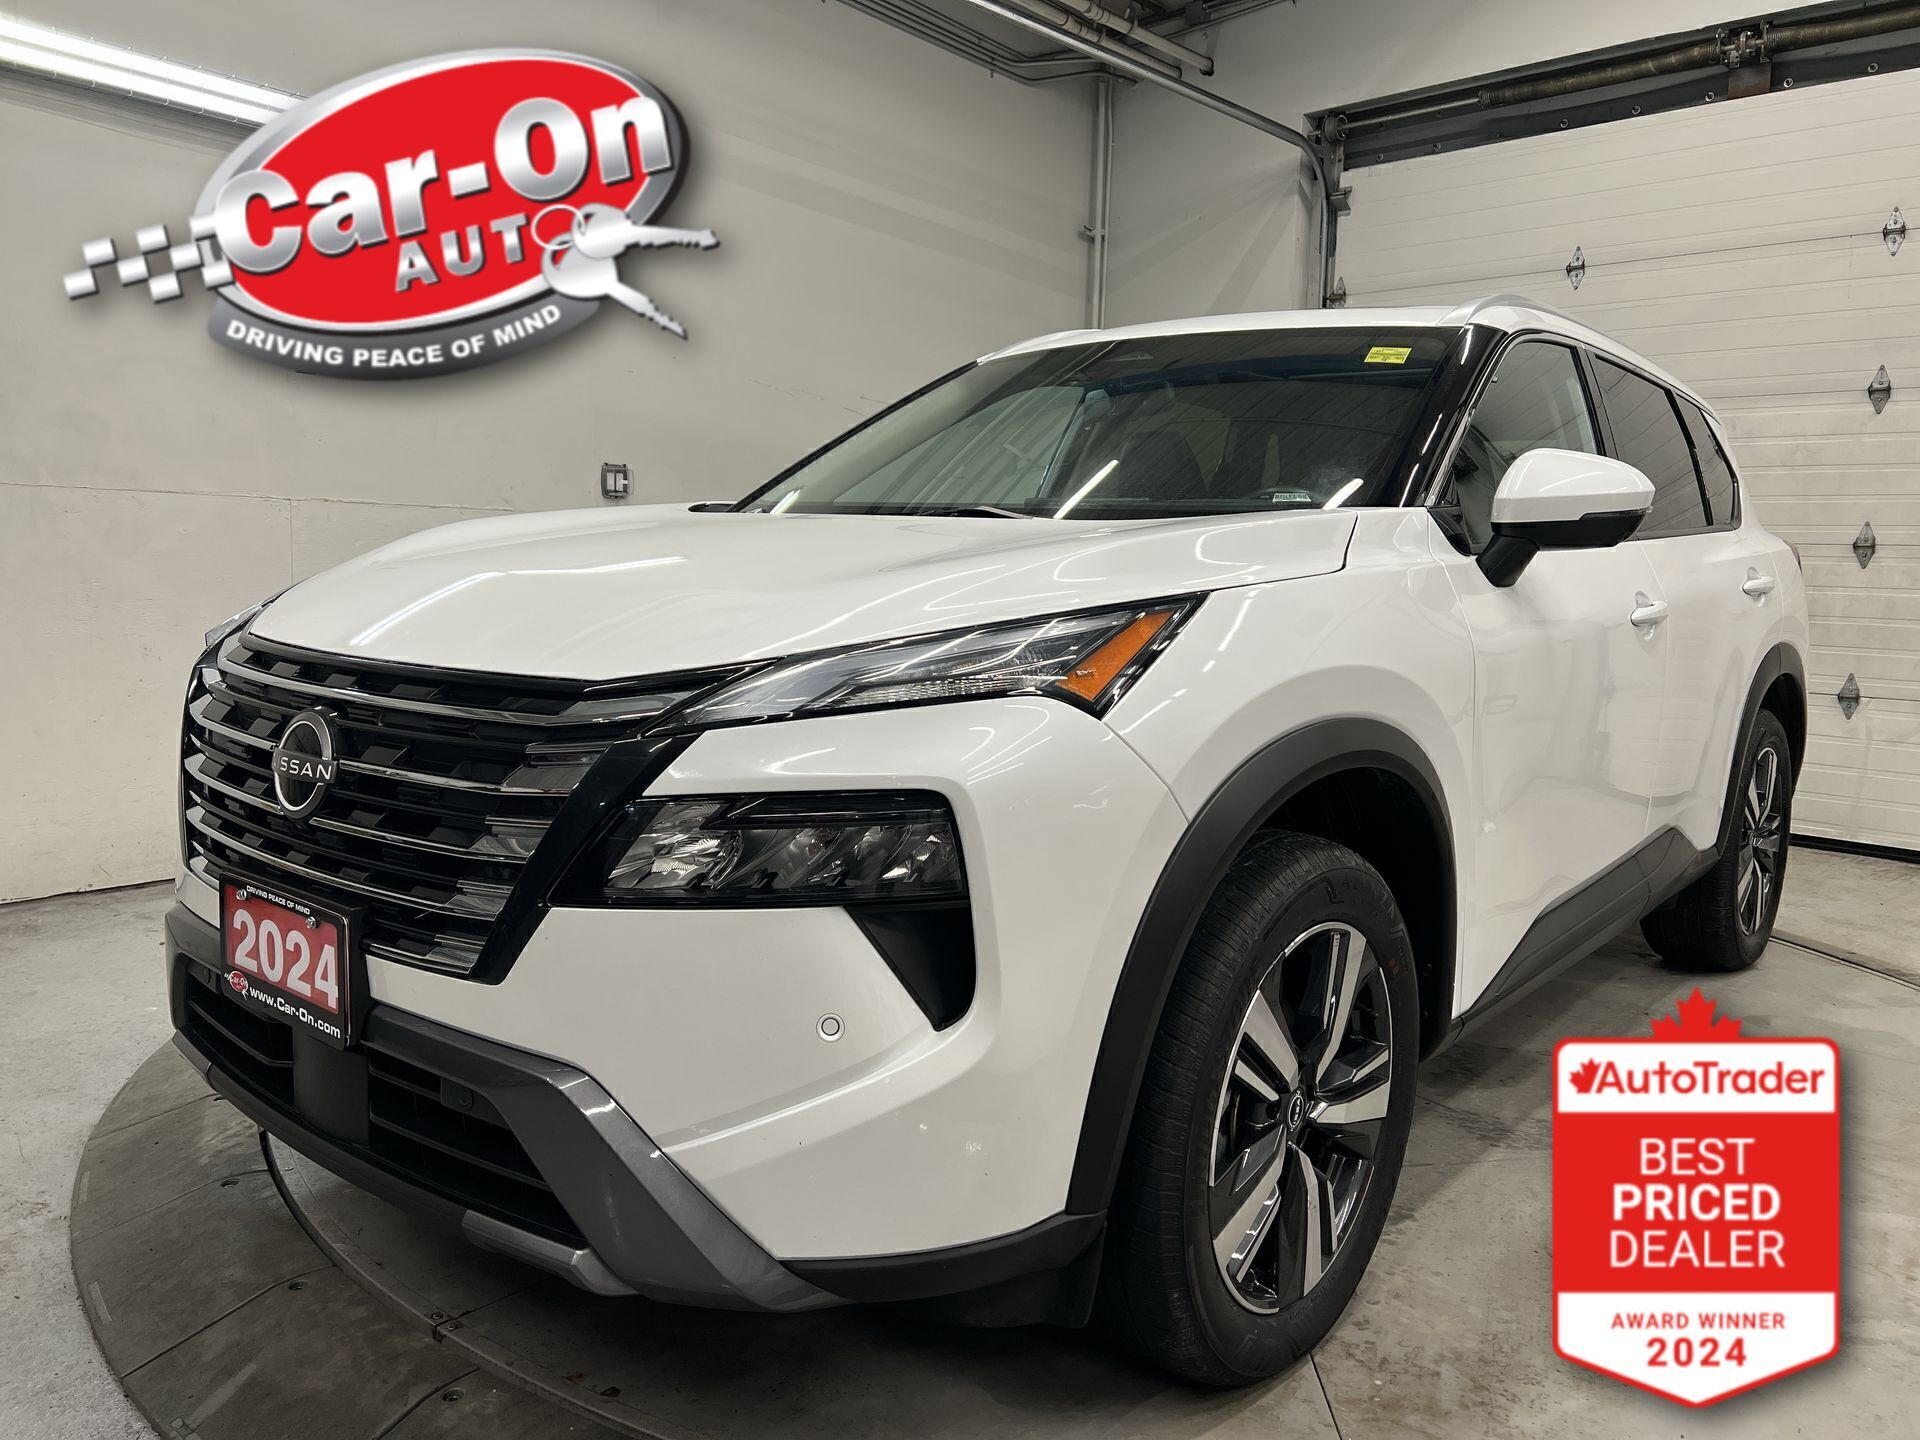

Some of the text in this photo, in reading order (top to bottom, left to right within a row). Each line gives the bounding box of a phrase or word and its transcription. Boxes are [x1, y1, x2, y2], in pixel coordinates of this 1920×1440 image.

[246, 885, 310, 915] DRIVING PEACE OF MIND
[233, 909, 339, 1010] 2024
[249, 986, 341, 1039] www.Car-On.com
